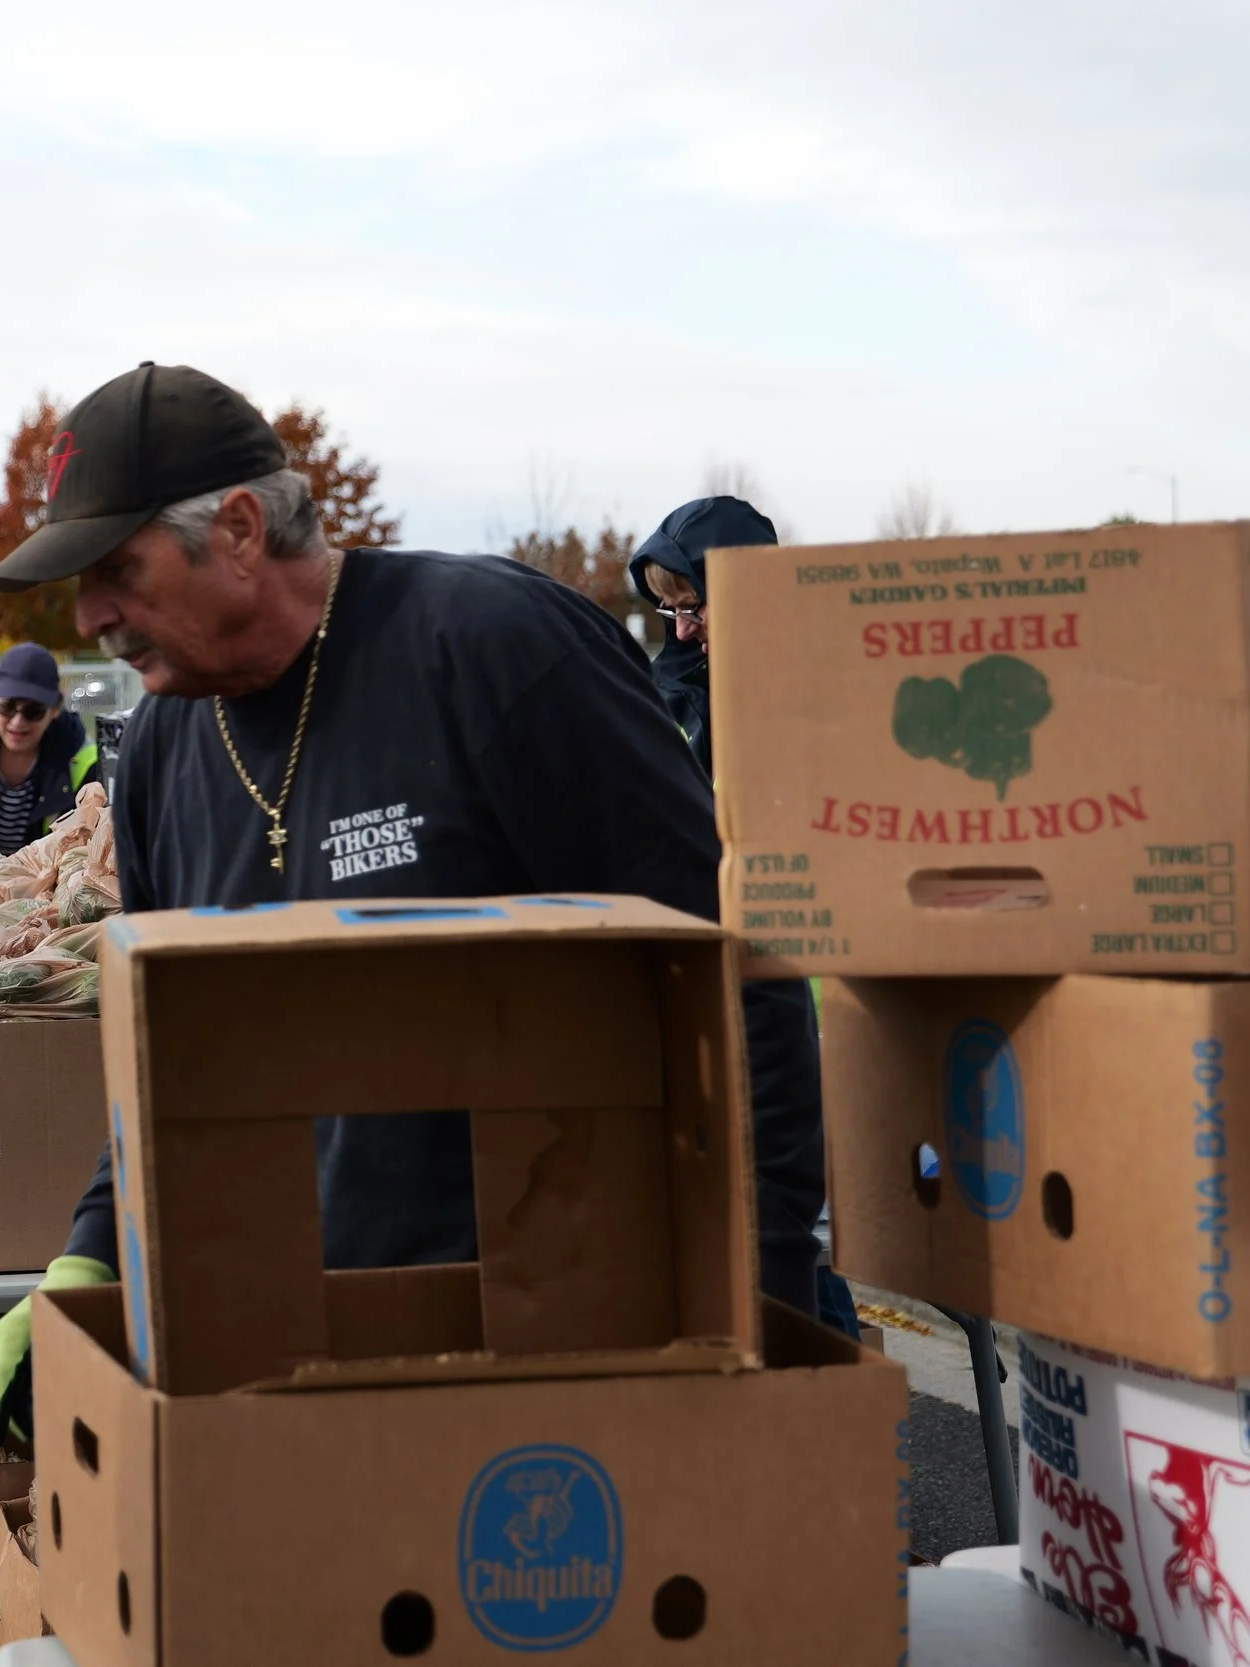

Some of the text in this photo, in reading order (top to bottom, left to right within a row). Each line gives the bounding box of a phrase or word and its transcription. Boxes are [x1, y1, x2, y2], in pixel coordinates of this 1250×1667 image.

[866, 560, 902, 580] WA
[1018, 554, 1035, 572] A
[849, 576, 1088, 606] IMPERIAL'S GARDEN
[861, 613, 1081, 659] PEPPERS
[328, 802, 408, 834] I'M ONE OF
[810, 785, 1149, 845] NORTHWEST
[328, 840, 419, 882] BIKERS
[789, 853, 810, 873] OF
[1144, 845, 1204, 866] SMALL
[741, 882, 817, 901] PRODUCE
[1133, 875, 1205, 895] MEDIUM
[742, 909, 833, 930] BY VOLUME
[1148, 904, 1206, 924] LARGE
[1090, 933, 1208, 954] EXTRA LARGE
[467, 1555, 613, 1614] Chiquita
